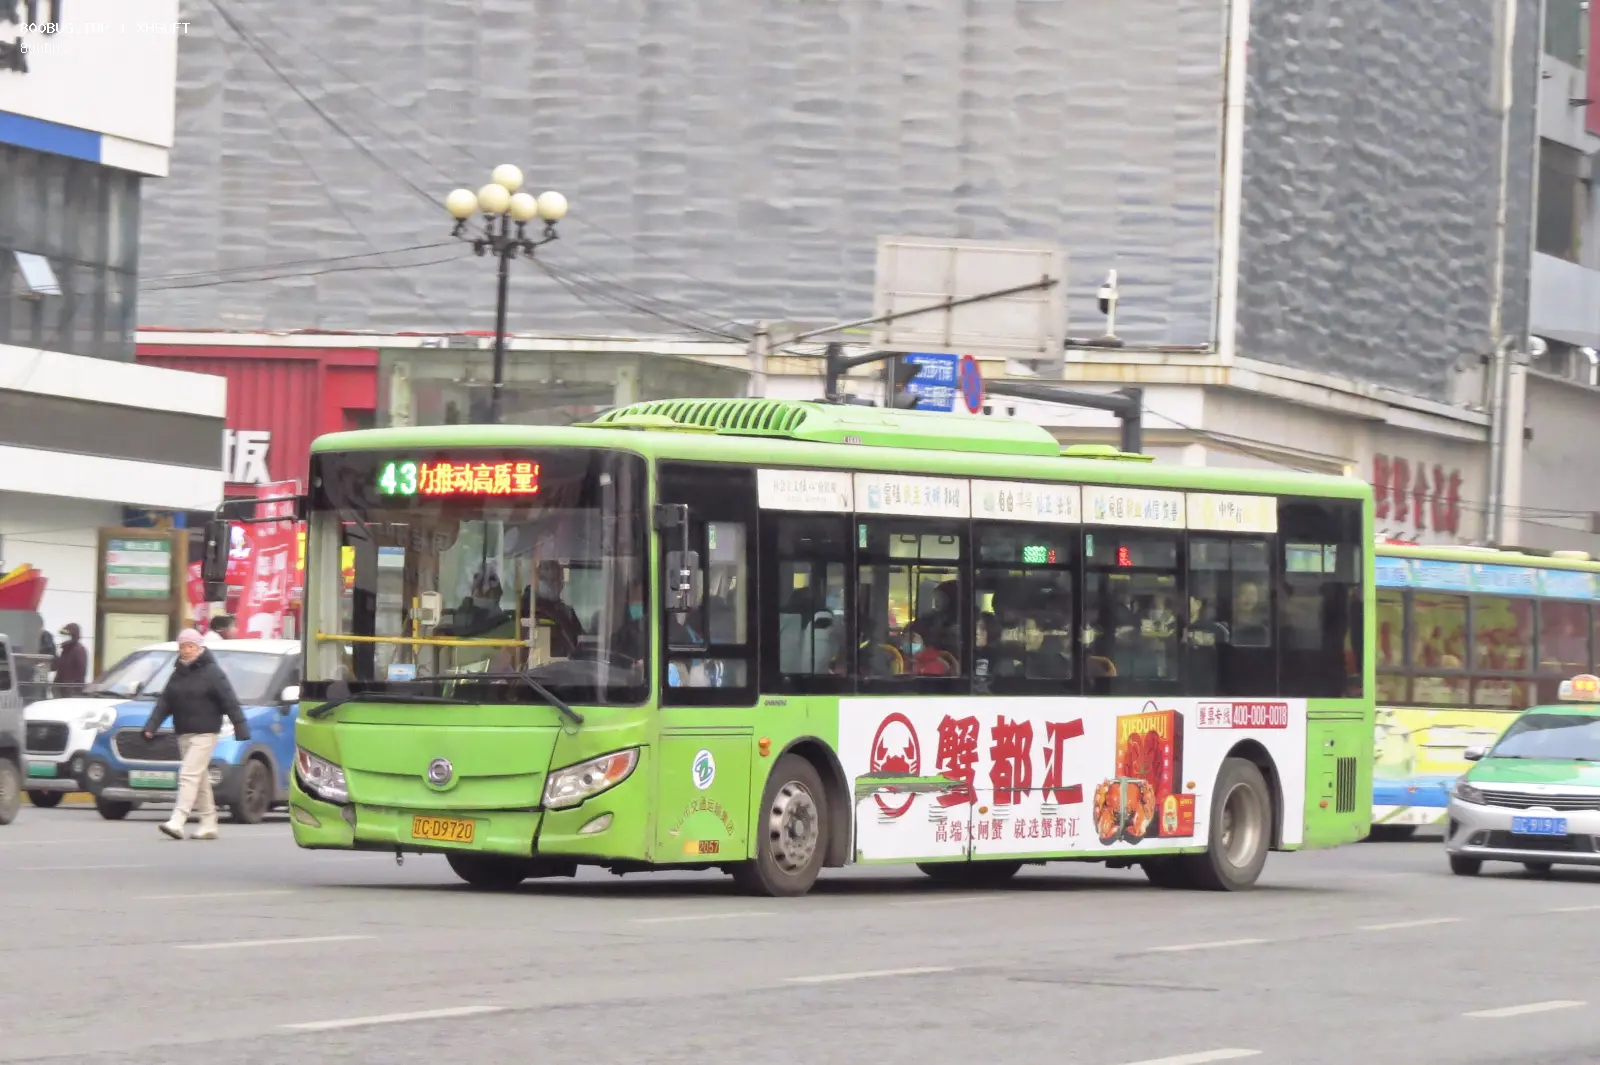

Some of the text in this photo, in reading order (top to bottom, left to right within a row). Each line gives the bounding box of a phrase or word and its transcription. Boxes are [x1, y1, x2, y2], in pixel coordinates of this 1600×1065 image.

[380, 462, 540, 494] 43 力推动高质量
[935, 714, 1085, 808] 蟹都汇
[935, 817, 1081, 843] 高端大闸蟹 就选蟹都汇
[699, 841, 719, 853] 2057
